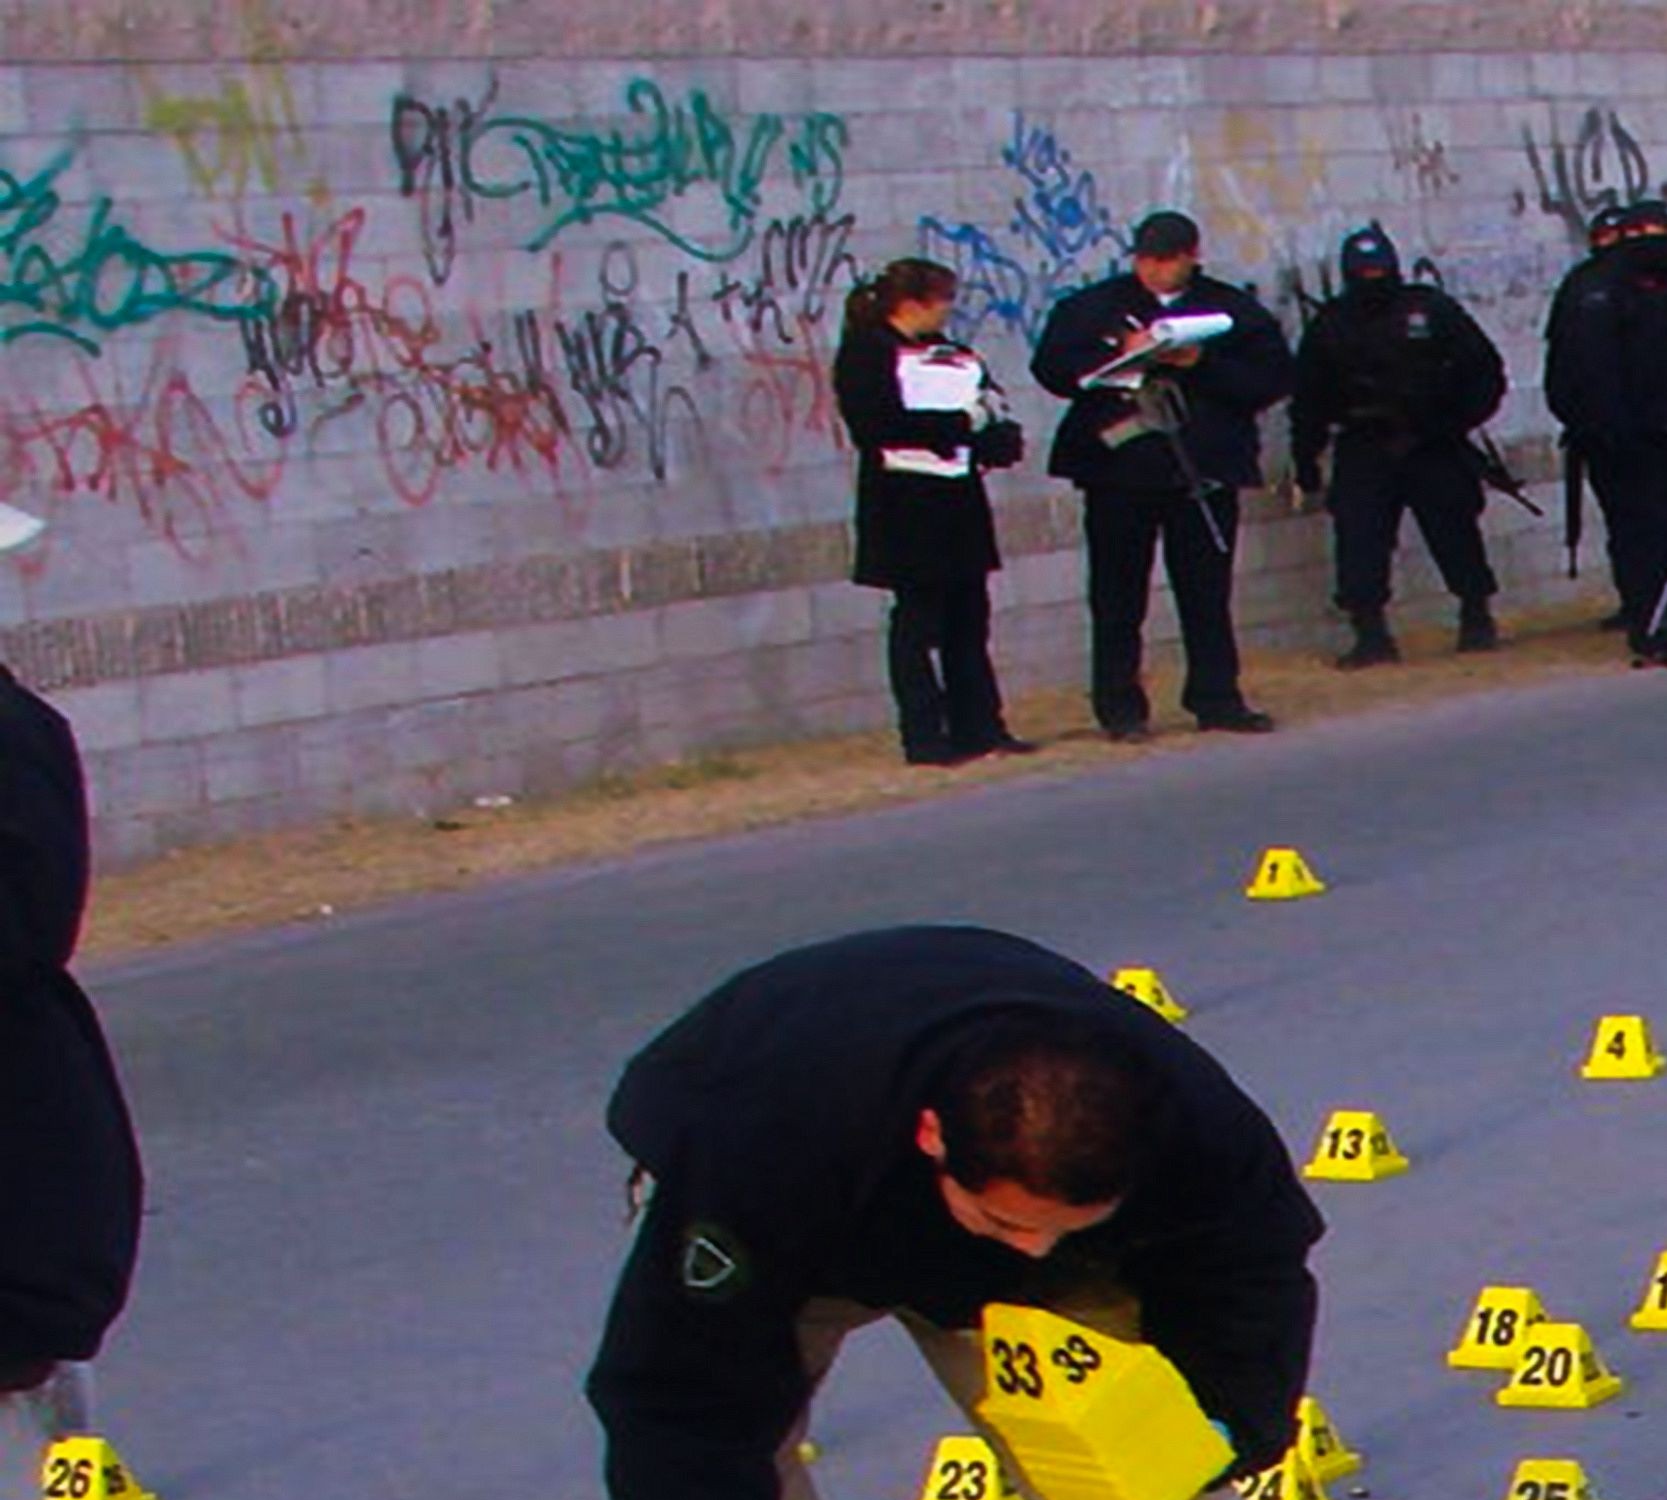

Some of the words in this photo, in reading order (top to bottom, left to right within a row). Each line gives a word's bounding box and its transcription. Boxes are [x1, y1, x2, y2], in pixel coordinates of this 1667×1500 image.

[1605, 1031, 1627, 1061] 4
[1324, 1127, 1364, 1162] 13
[1475, 1308, 1516, 1346] 18
[991, 1337, 1046, 1399] 33
[1519, 1346, 1573, 1386] 20
[45, 1458, 94, 1500] 26
